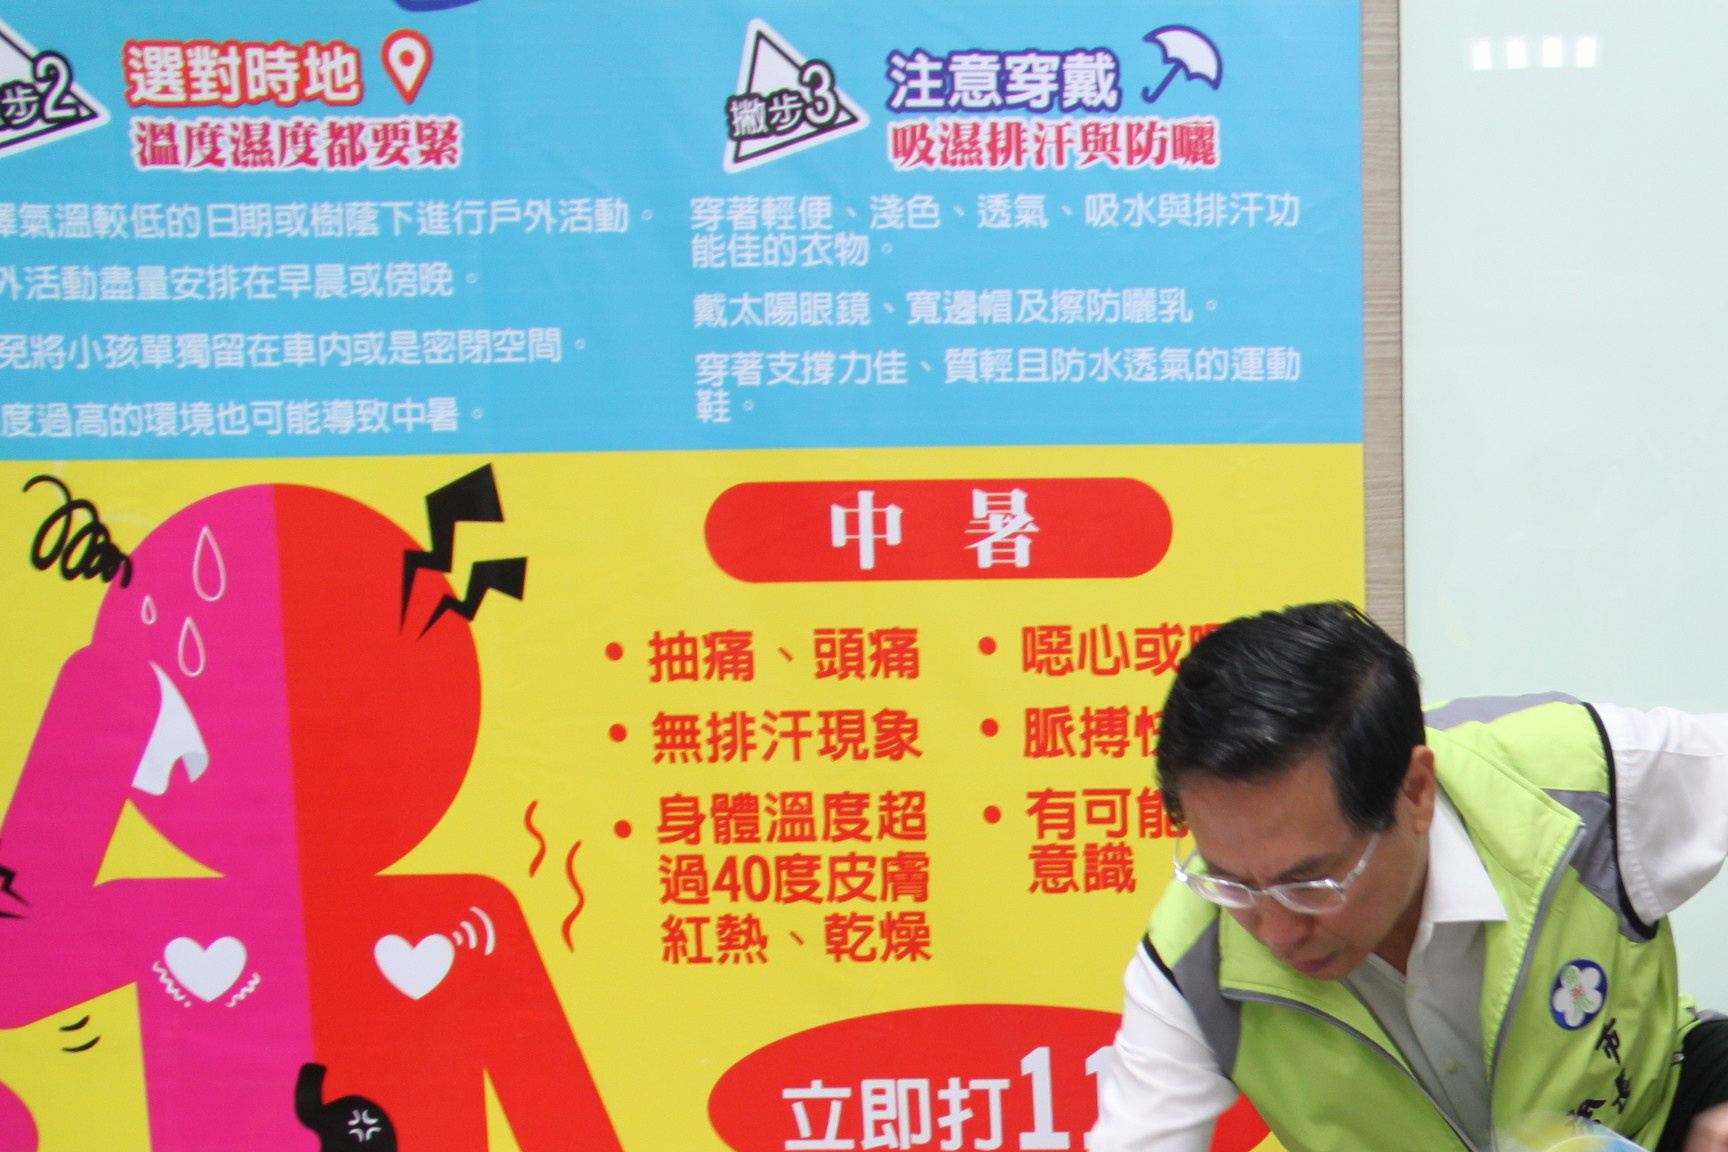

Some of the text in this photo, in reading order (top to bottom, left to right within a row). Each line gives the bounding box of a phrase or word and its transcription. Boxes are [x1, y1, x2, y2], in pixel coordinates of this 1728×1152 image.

[126, 42, 360, 104] 選對時地
[889, 51, 1118, 109] 注意穿戴
[134, 119, 460, 168] 溫度濕度都要緊
[892, 118, 1217, 168] 吸濕排汗與防曬
[691, 232, 892, 269] 能佳的衣物。
[695, 388, 753, 423] 鞋。
[830, 487, 1040, 570] 中暑
[648, 626, 921, 684] 抽痛、頭痛
[1022, 622, 1228, 677] 噁心或
[652, 708, 924, 764] 無排汗現象
[657, 790, 928, 847] 身體溫度超
[658, 852, 931, 906] 過40度皮膚
[1028, 842, 1137, 896] 意識
[661, 912, 934, 966] 紅熱、乾燥
